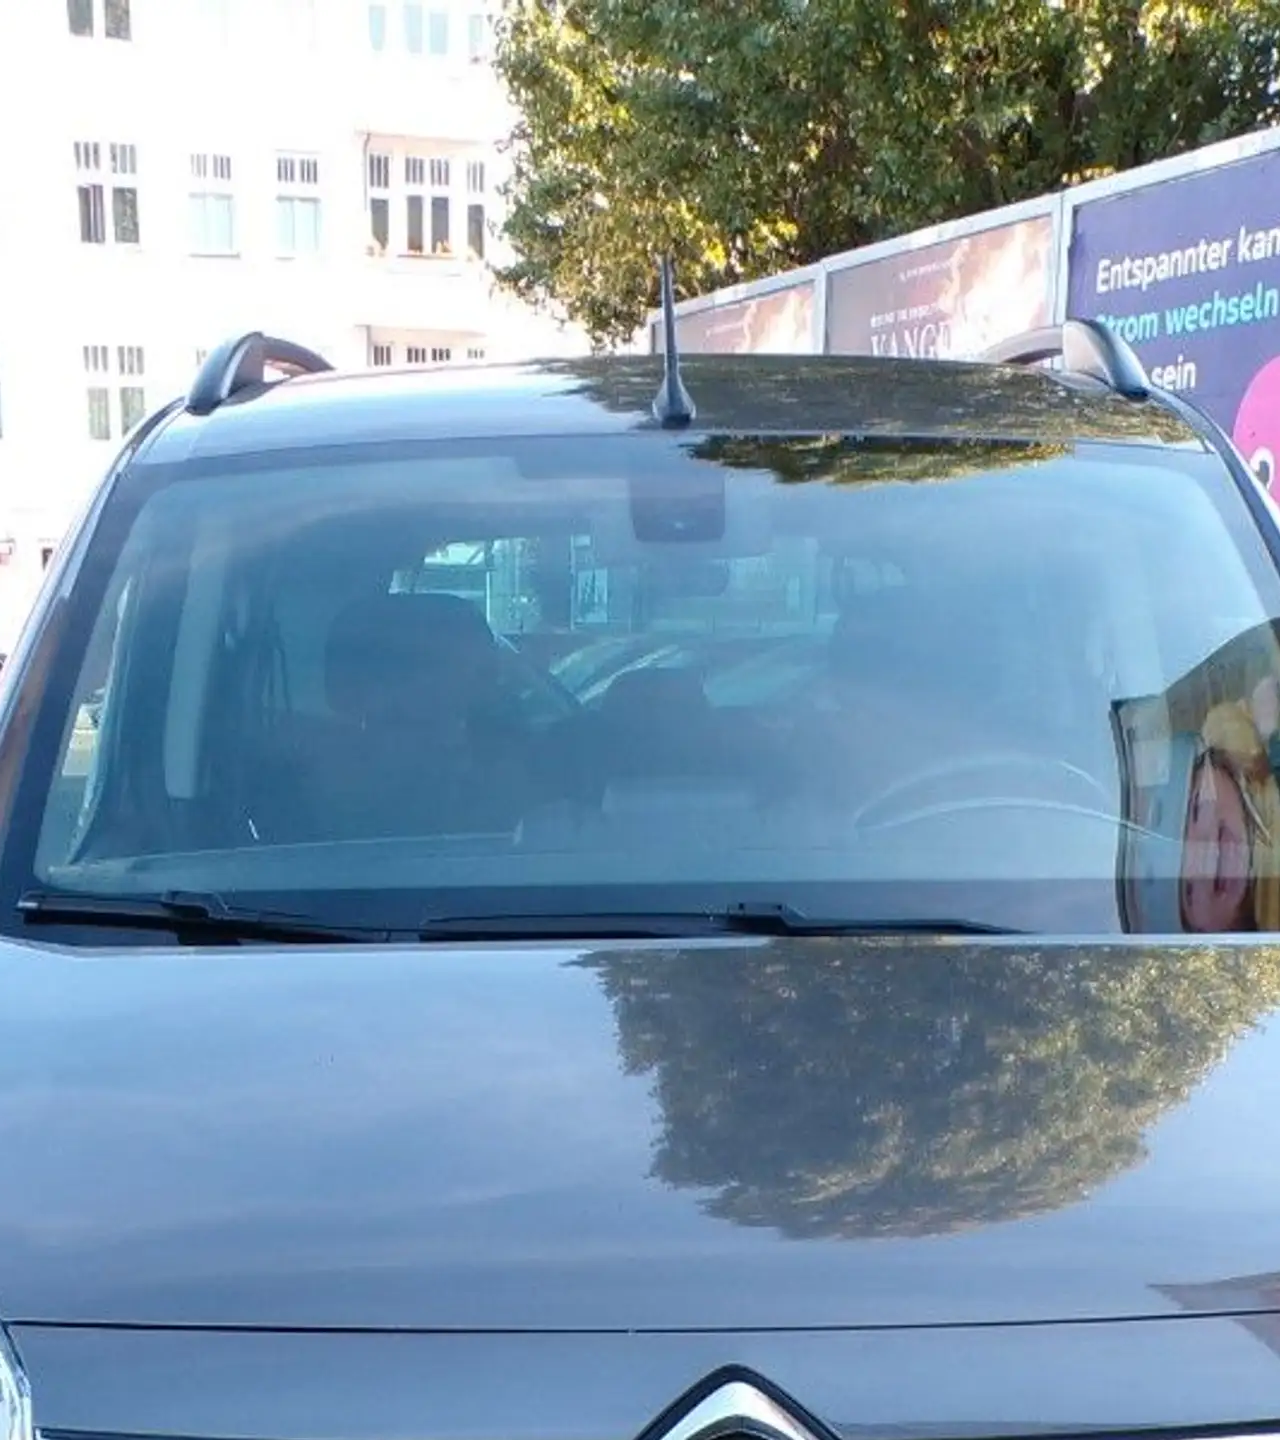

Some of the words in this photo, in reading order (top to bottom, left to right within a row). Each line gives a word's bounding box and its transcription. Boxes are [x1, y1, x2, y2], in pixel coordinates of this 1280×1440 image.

[1095, 237, 1233, 294] Entspannter
[1164, 281, 1280, 336] wechseln
[1151, 353, 1197, 390] sein
